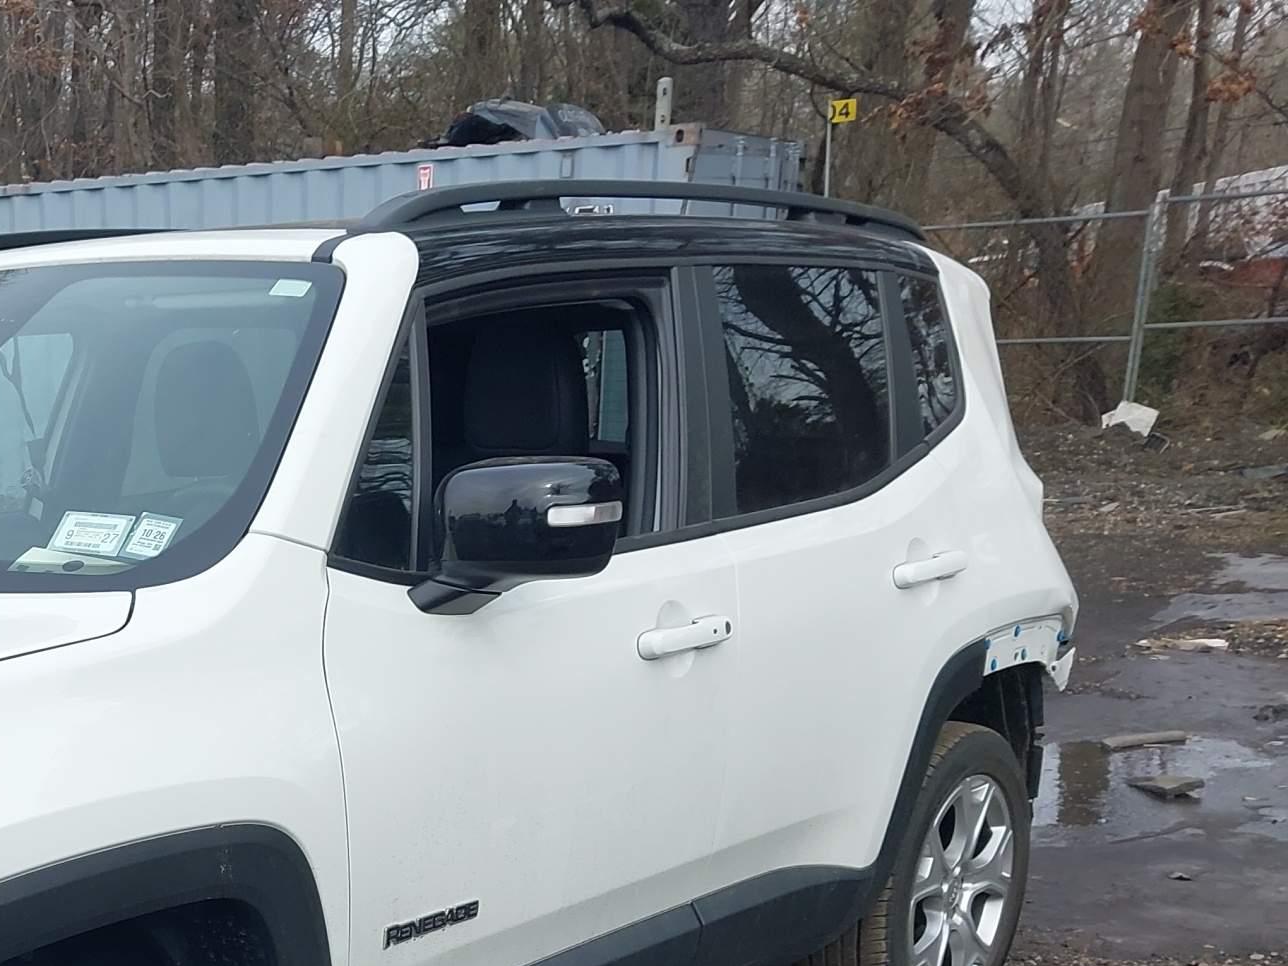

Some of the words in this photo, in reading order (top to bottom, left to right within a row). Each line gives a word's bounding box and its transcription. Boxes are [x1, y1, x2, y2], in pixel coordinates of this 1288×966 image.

[65, 530, 75, 540] 9
[101, 533, 120, 544] 27
[141, 529, 153, 538] 10
[153, 531, 167, 541] 26
[382, 899, 480, 951] RENEGADE
